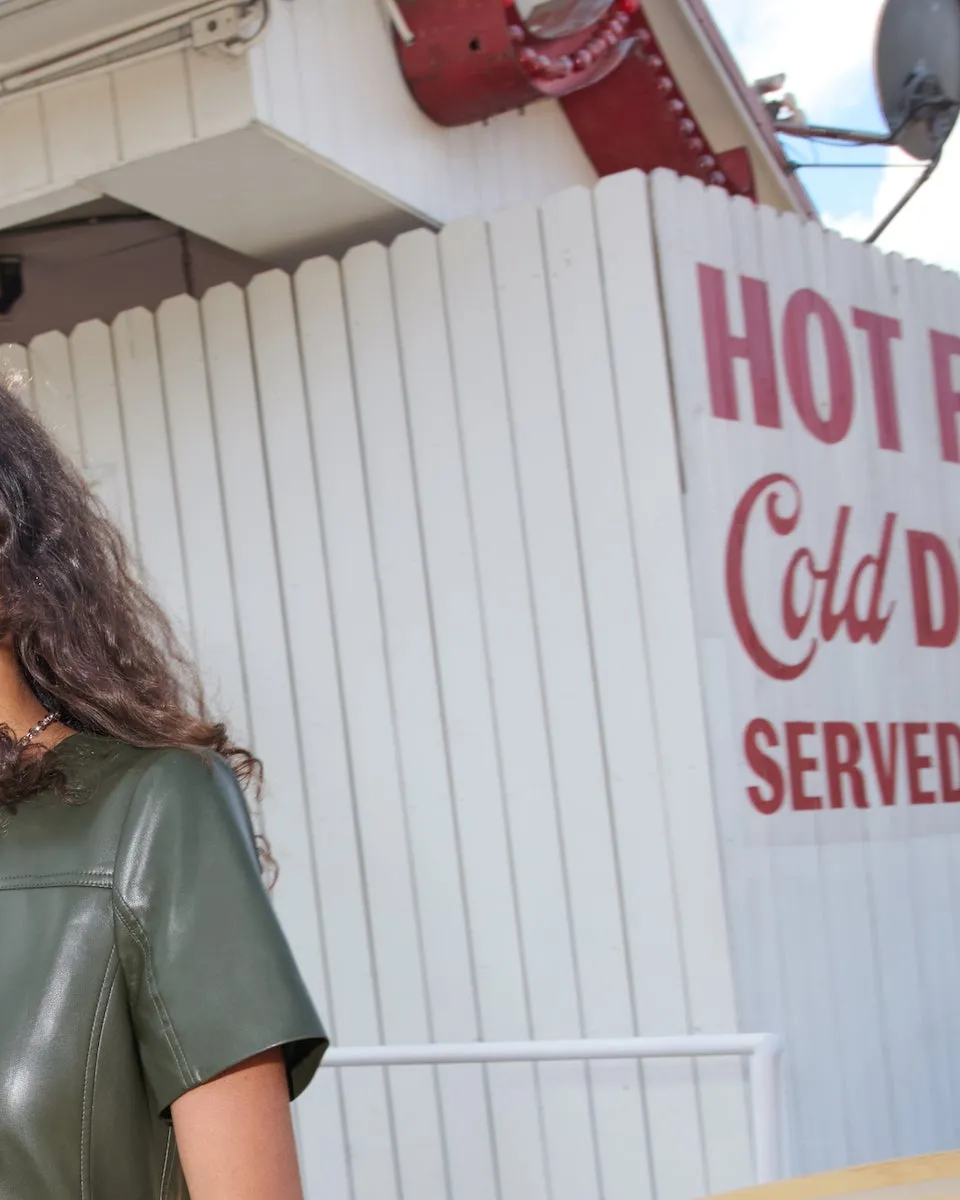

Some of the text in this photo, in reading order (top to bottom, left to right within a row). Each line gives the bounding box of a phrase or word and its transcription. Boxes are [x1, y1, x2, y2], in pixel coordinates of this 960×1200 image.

[697, 263, 902, 453] HOT
[725, 473, 897, 681] Cold
[743, 717, 960, 816] SERVED
